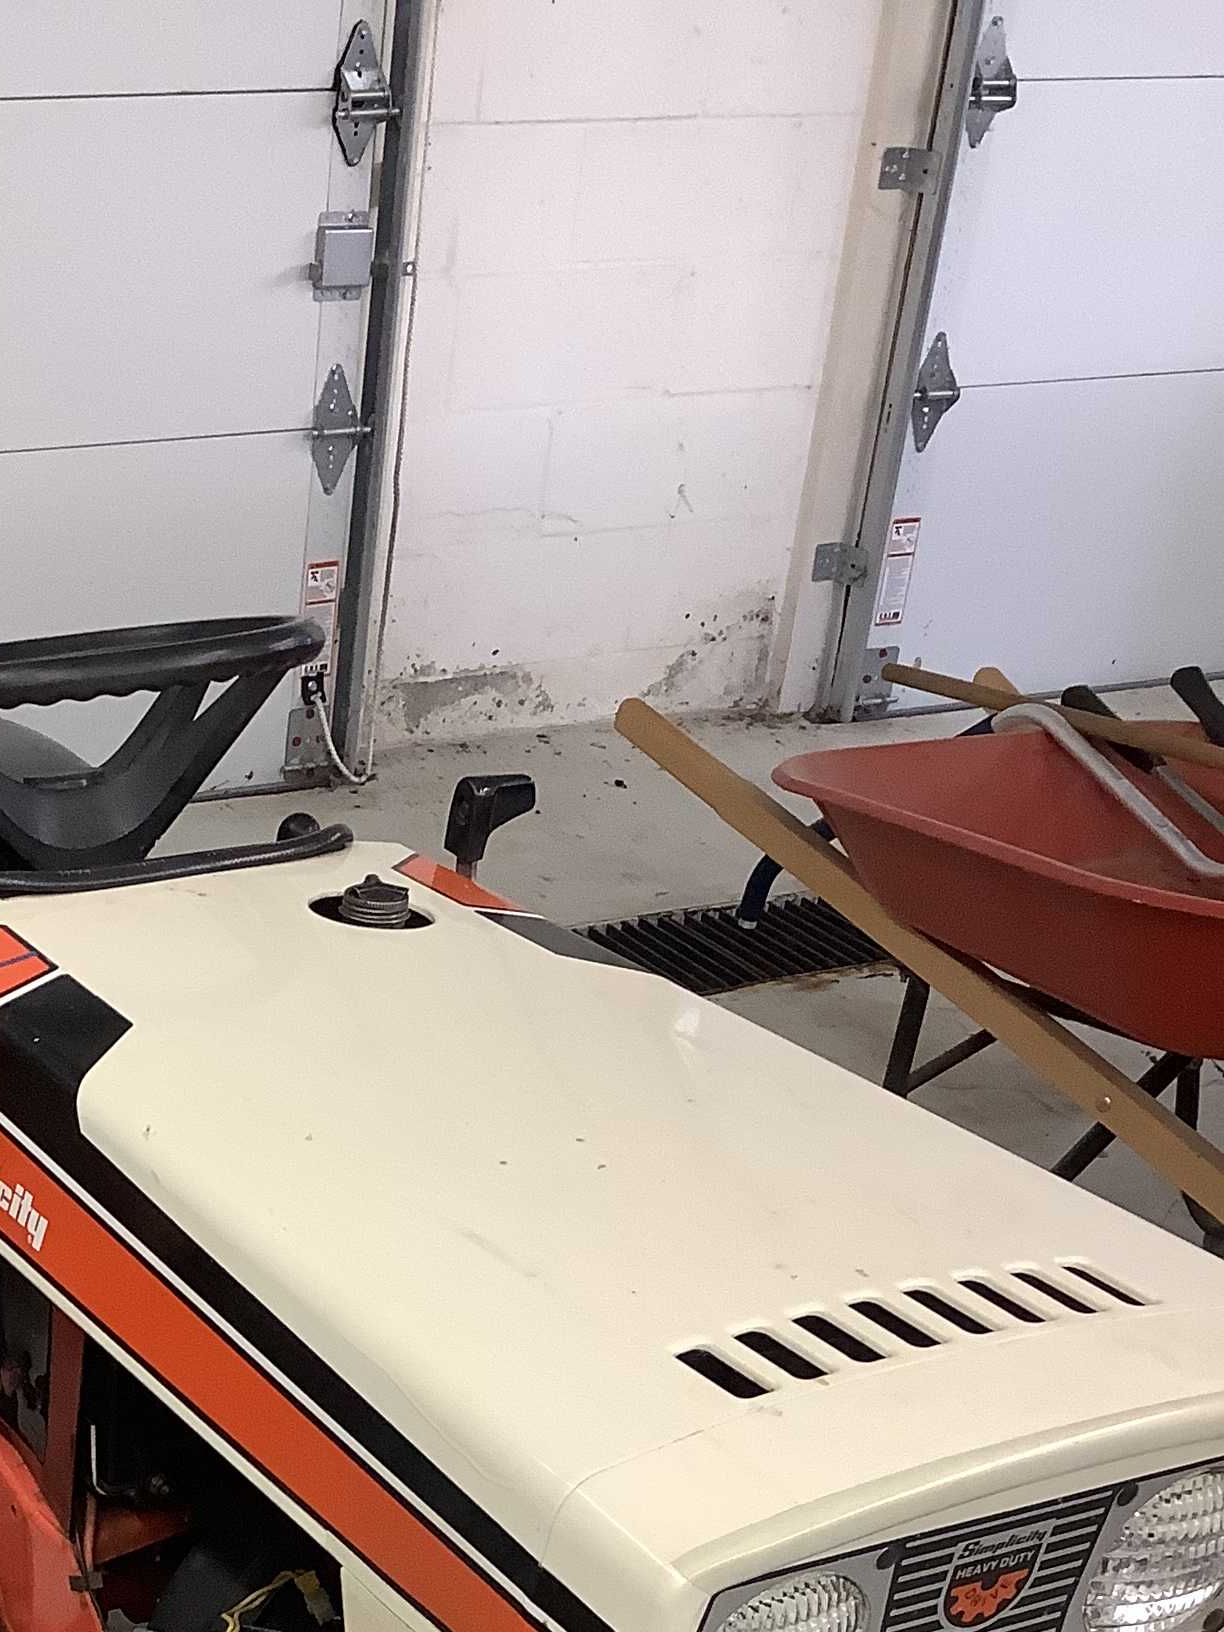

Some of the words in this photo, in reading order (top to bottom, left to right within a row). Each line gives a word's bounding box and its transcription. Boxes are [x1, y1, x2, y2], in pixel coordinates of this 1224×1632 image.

[957, 1530, 1048, 1559] Simplicity
[956, 1560, 999, 1580] HEAVY
[999, 1550, 1036, 1568] DUTY
